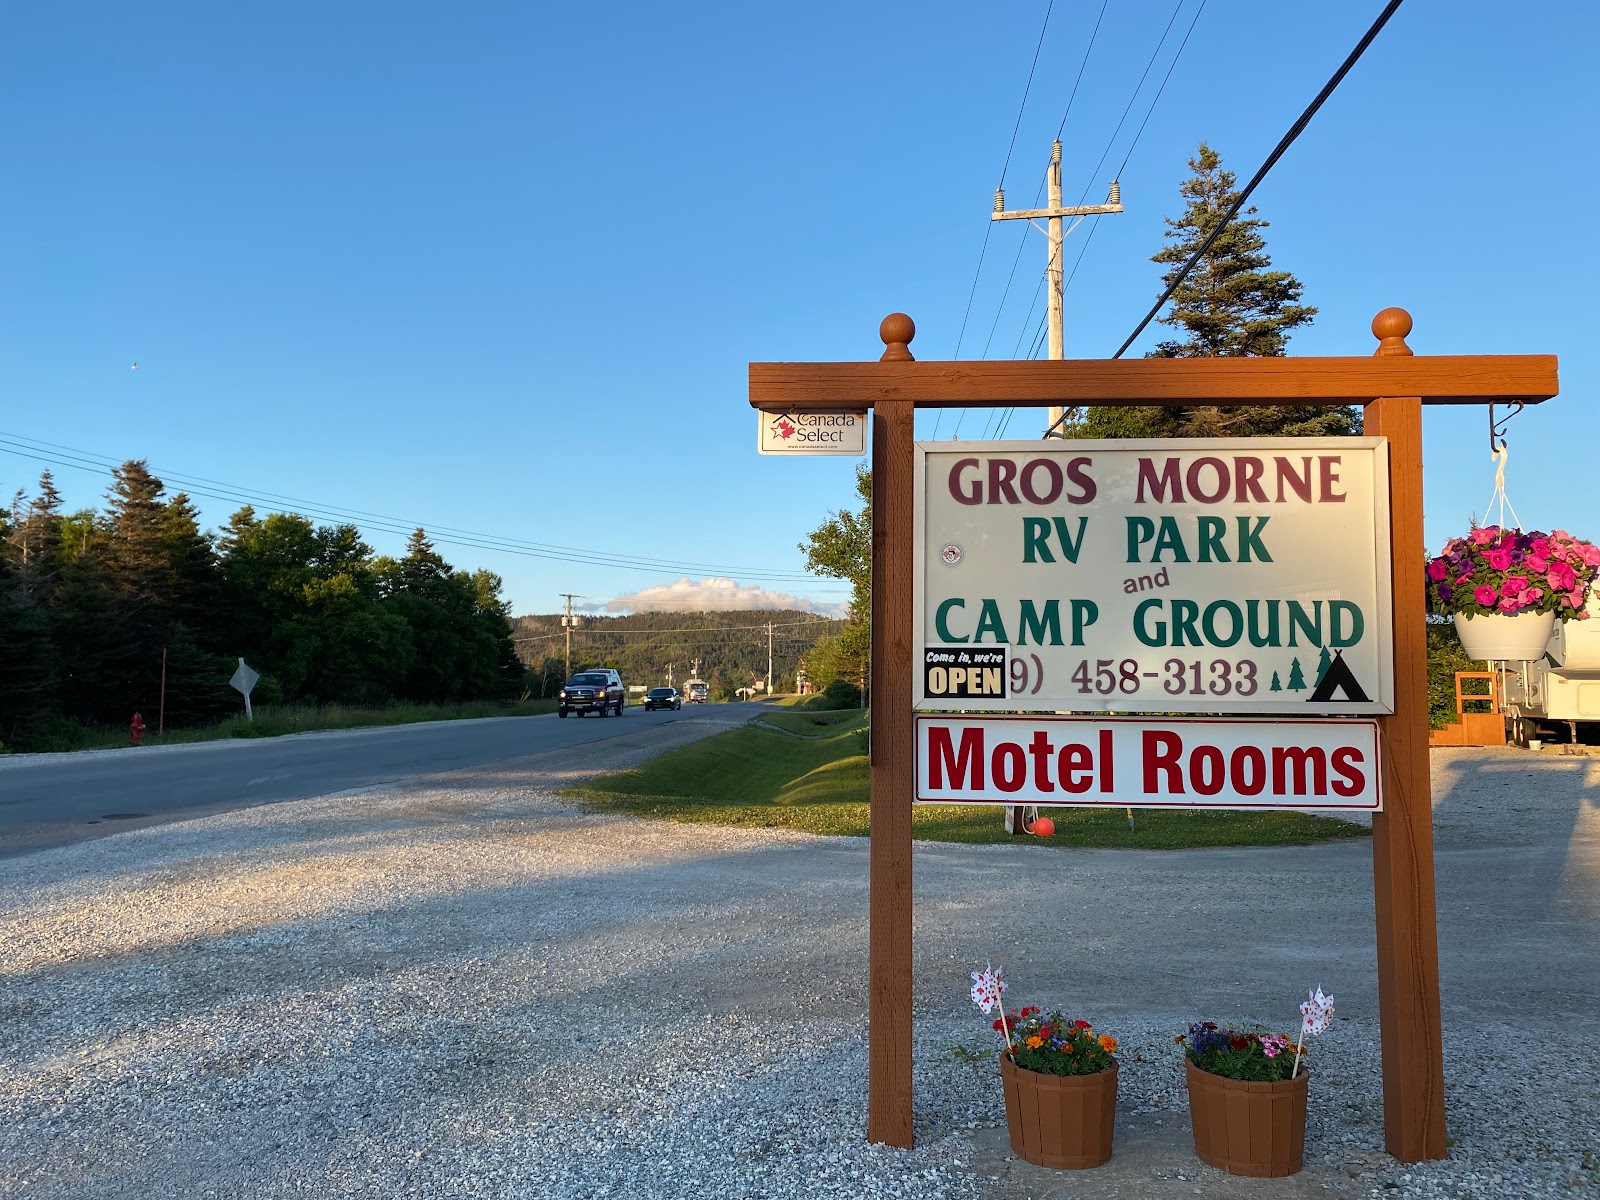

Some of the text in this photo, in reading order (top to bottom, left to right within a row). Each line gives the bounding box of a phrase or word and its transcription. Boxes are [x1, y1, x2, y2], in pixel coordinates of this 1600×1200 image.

[797, 428, 844, 442] Select
[798, 413, 854, 426] Canada
[948, 456, 1347, 505] GROS MORNE
[1022, 515, 1274, 564] RV PARK
[1123, 567, 1170, 594] and
[935, 597, 1364, 648] CAMP GROUND
[926, 652, 1003, 664] Come in, we're
[929, 667, 1001, 694] OPEN
[1071, 657, 1258, 696] 458-3133
[929, 726, 1366, 797] Motel Rooms
